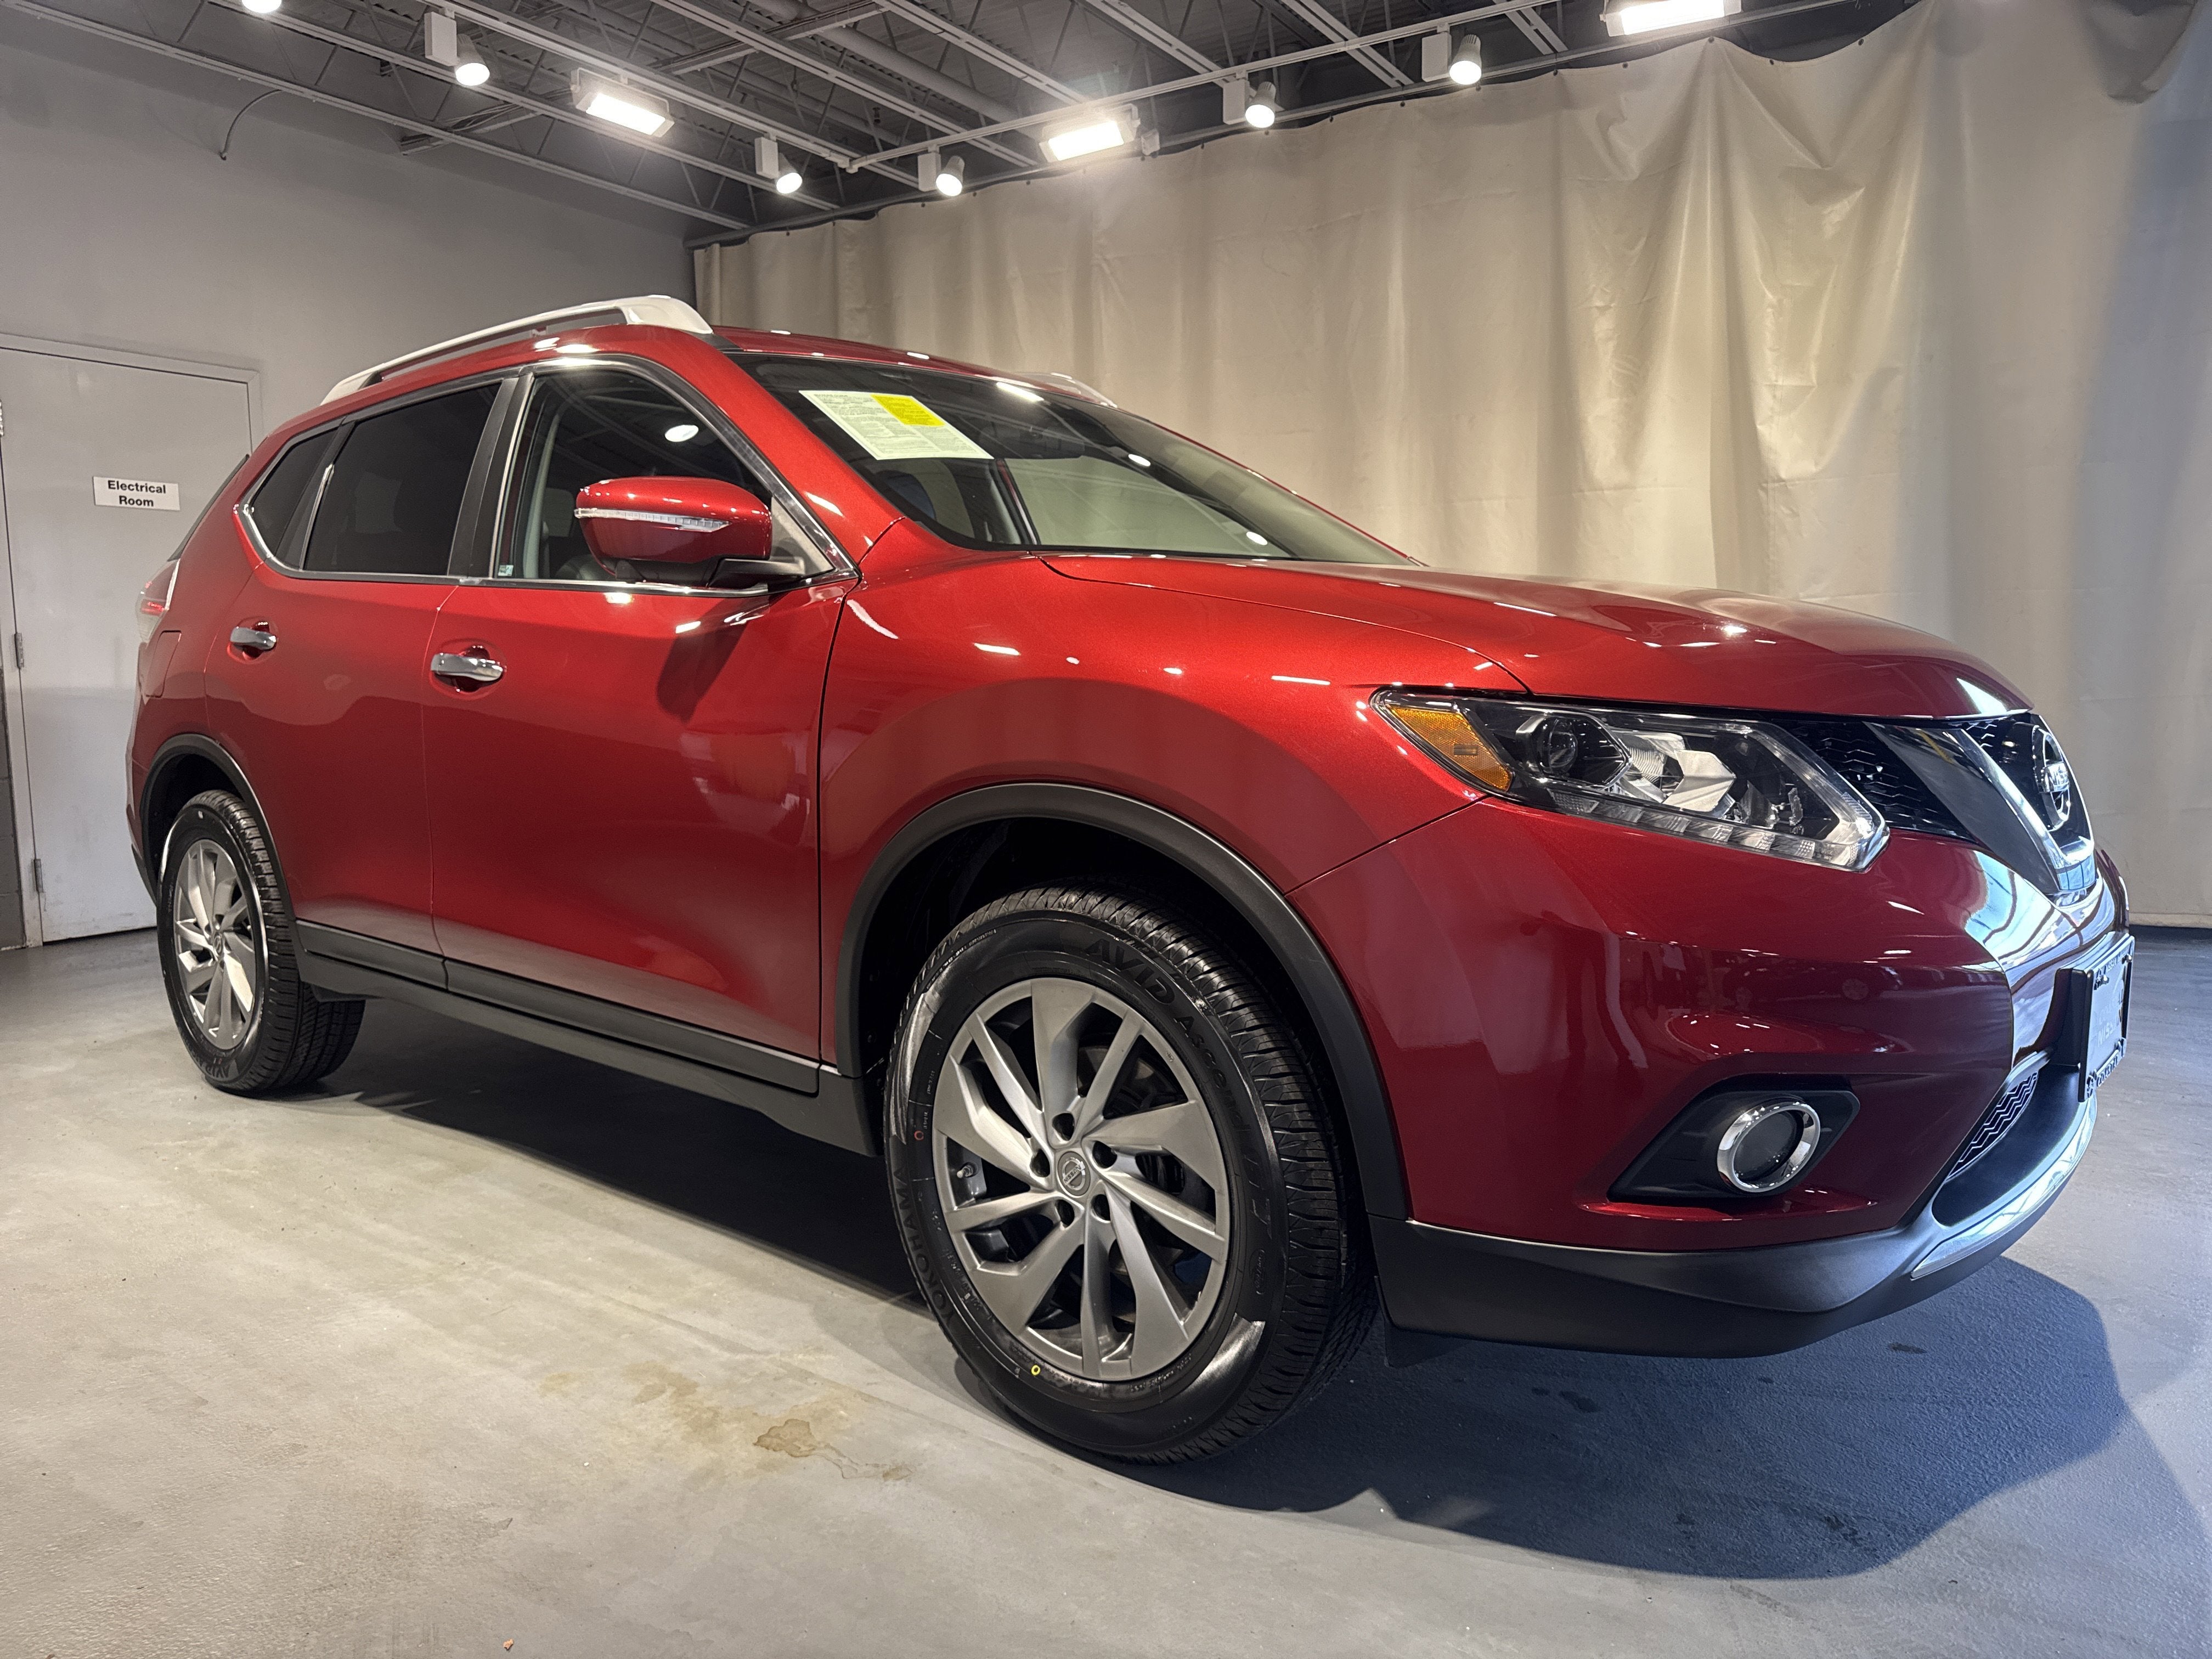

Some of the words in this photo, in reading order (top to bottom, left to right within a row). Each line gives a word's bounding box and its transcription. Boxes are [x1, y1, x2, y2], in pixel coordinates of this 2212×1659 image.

[108, 480, 166, 494] Electrical
[119, 495, 154, 507] Room
[1083, 938, 1176, 1006] AVID
[1173, 1015, 1253, 1132] Ascend
[1063, 1164, 1082, 1183] NISSAN
[893, 1165, 956, 1325] YOKOHAMA
